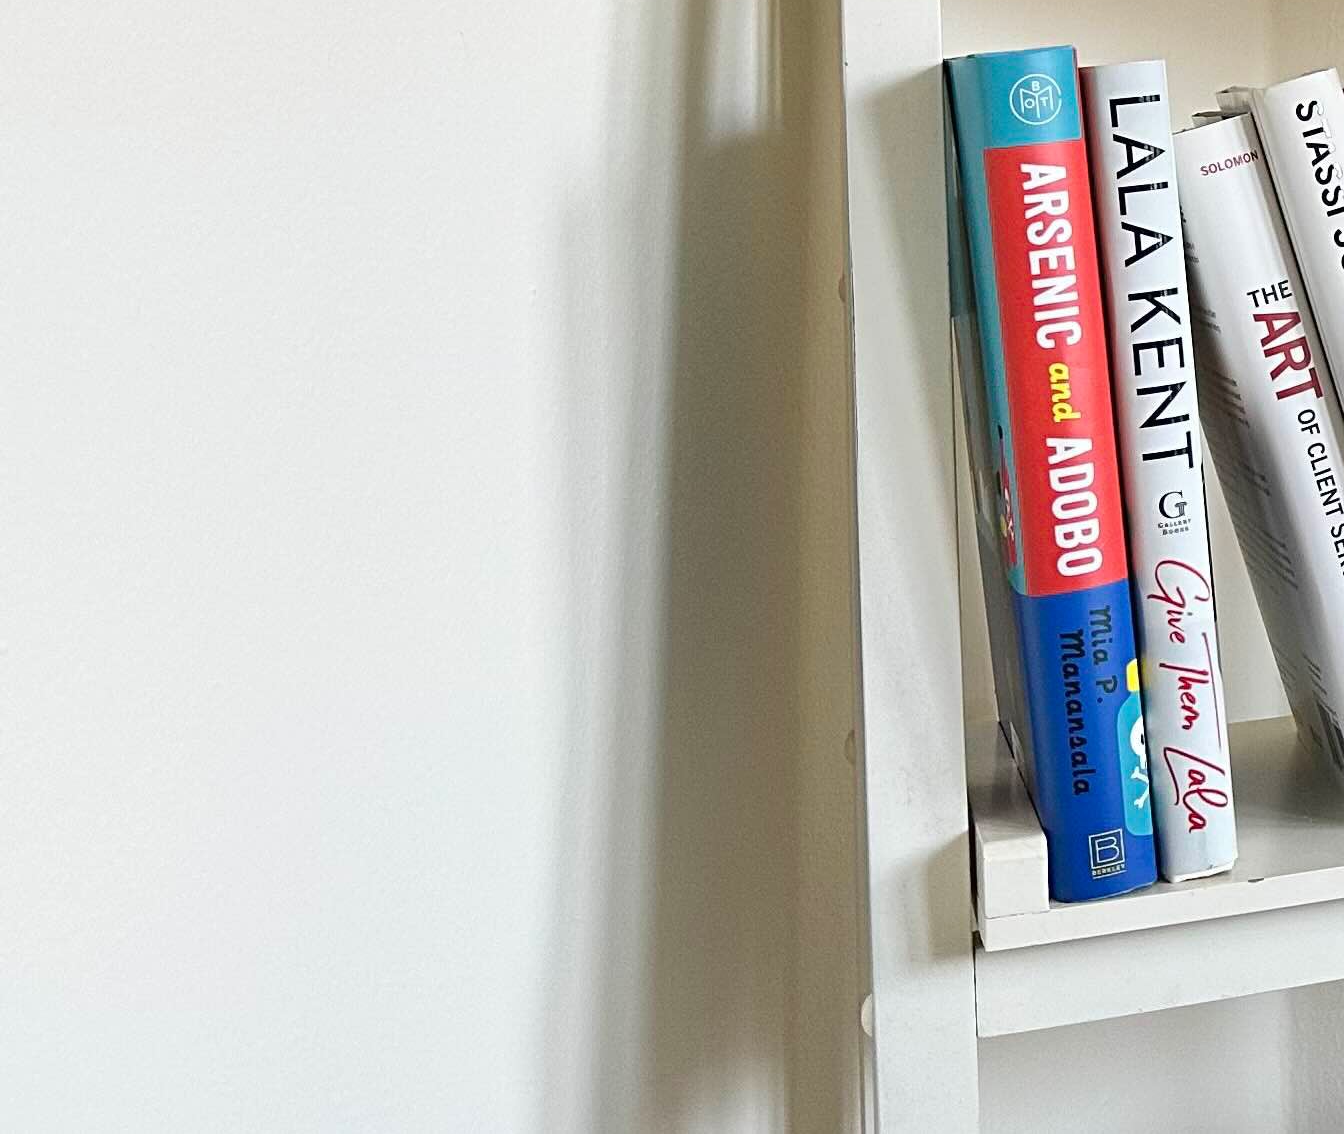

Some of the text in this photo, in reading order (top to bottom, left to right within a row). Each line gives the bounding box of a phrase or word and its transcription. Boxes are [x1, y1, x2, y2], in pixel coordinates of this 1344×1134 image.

[1200, 150, 1259, 177] SOLOMON
[1109, 94, 1194, 469] LALA KENT
[1247, 279, 1294, 308] THE
[1020, 162, 1103, 577] ARSENIC and ADOBO
[1253, 312, 1322, 400] ART
[1298, 409, 1320, 444] OF
[1307, 441, 1344, 517] CLIENT
[1089, 605, 1111, 666] Mia
[1057, 630, 1095, 796] Manansala
[1147, 560, 1228, 833] Give Them Lala
